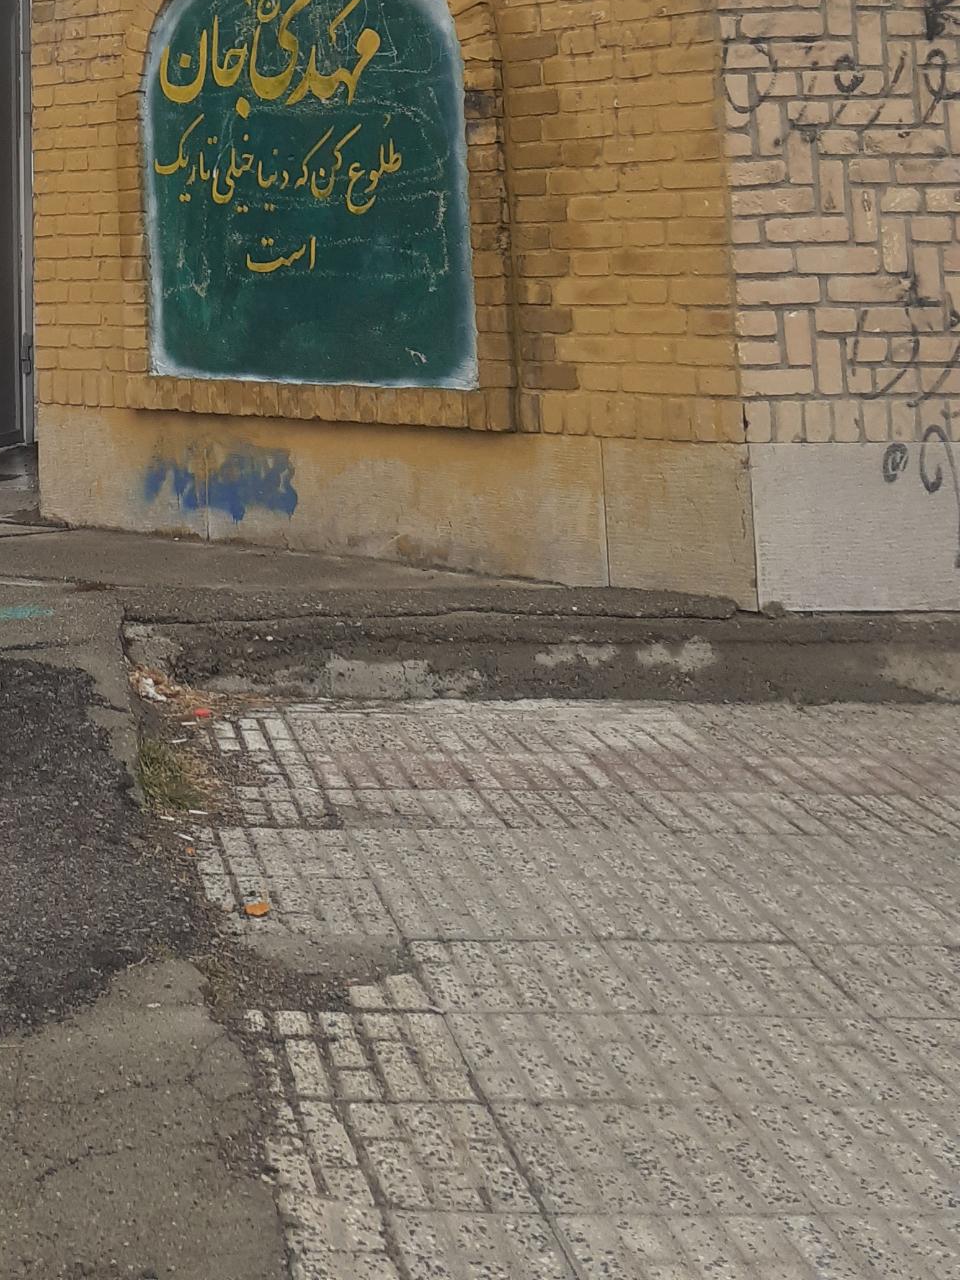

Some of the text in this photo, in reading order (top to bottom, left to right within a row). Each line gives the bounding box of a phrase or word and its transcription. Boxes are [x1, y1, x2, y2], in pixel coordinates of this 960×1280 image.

[160, 14, 248, 120] جان
[154, 114, 218, 203] تاریک
[212, 134, 255, 213] خیلی
[257, 149, 290, 212] دنیا
[295, 126, 334, 189] که
[311, 124, 361, 199] کن
[246, 235, 316, 273] است
